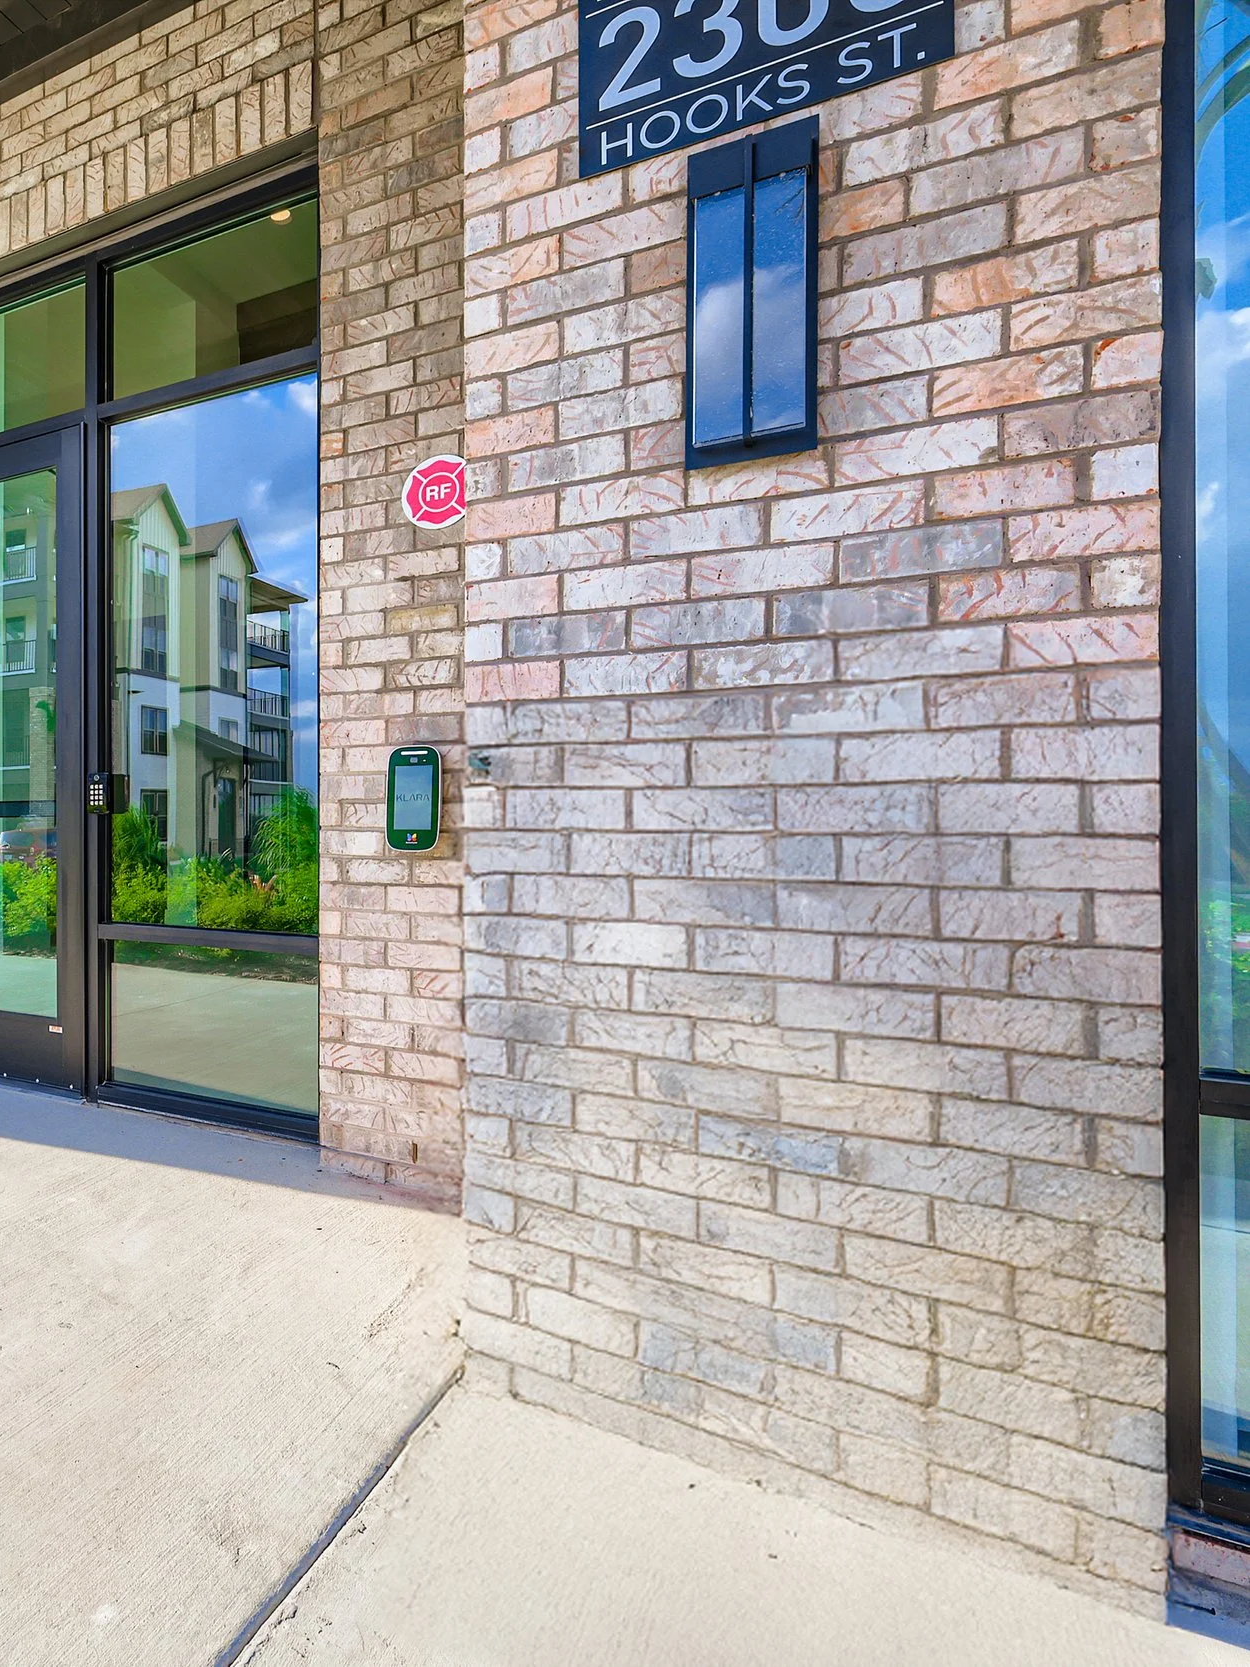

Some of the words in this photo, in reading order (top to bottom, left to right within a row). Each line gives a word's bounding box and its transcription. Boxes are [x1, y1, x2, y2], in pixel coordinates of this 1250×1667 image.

[599, 0, 903, 112] 23
[600, 63, 811, 165] HOOKS
[837, 23, 926, 84] ST.
[425, 482, 452, 502] RF
[396, 793, 430, 802] KLARA
